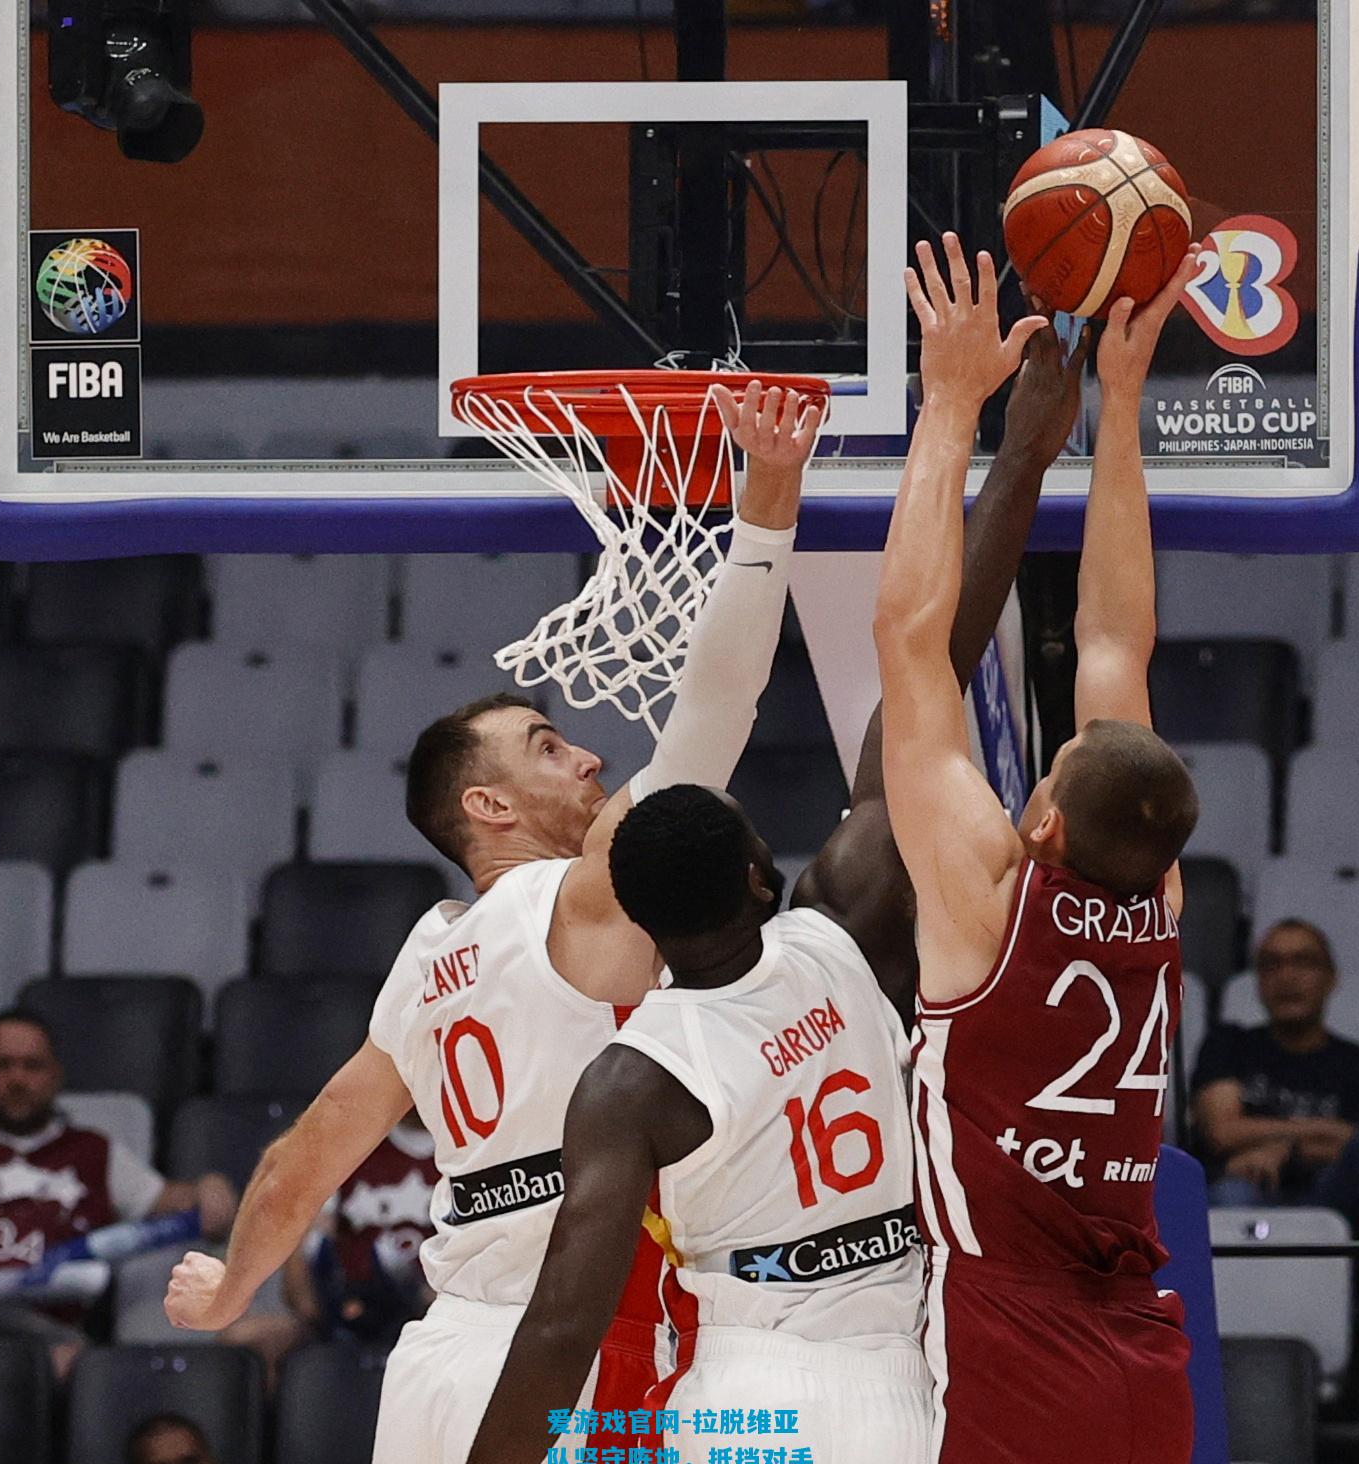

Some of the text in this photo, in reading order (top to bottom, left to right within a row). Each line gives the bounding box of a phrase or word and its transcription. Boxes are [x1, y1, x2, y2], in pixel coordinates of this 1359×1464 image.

[48, 361, 123, 399] FIBA
[1218, 376, 1253, 394] FIBA
[1156, 411, 1317, 435] WORLD CUP
[1157, 397, 1313, 412] BASKETBALL
[43, 430, 130, 444] We Are Basketball
[1024, 960, 1170, 1117] 24
[433, 1016, 504, 1149] 10
[783, 1068, 884, 1209] 16
[451, 1157, 565, 1218] CaixaBan
[1103, 1157, 1158, 1182] Rimi
[788, 1218, 921, 1276] CaixaBa
